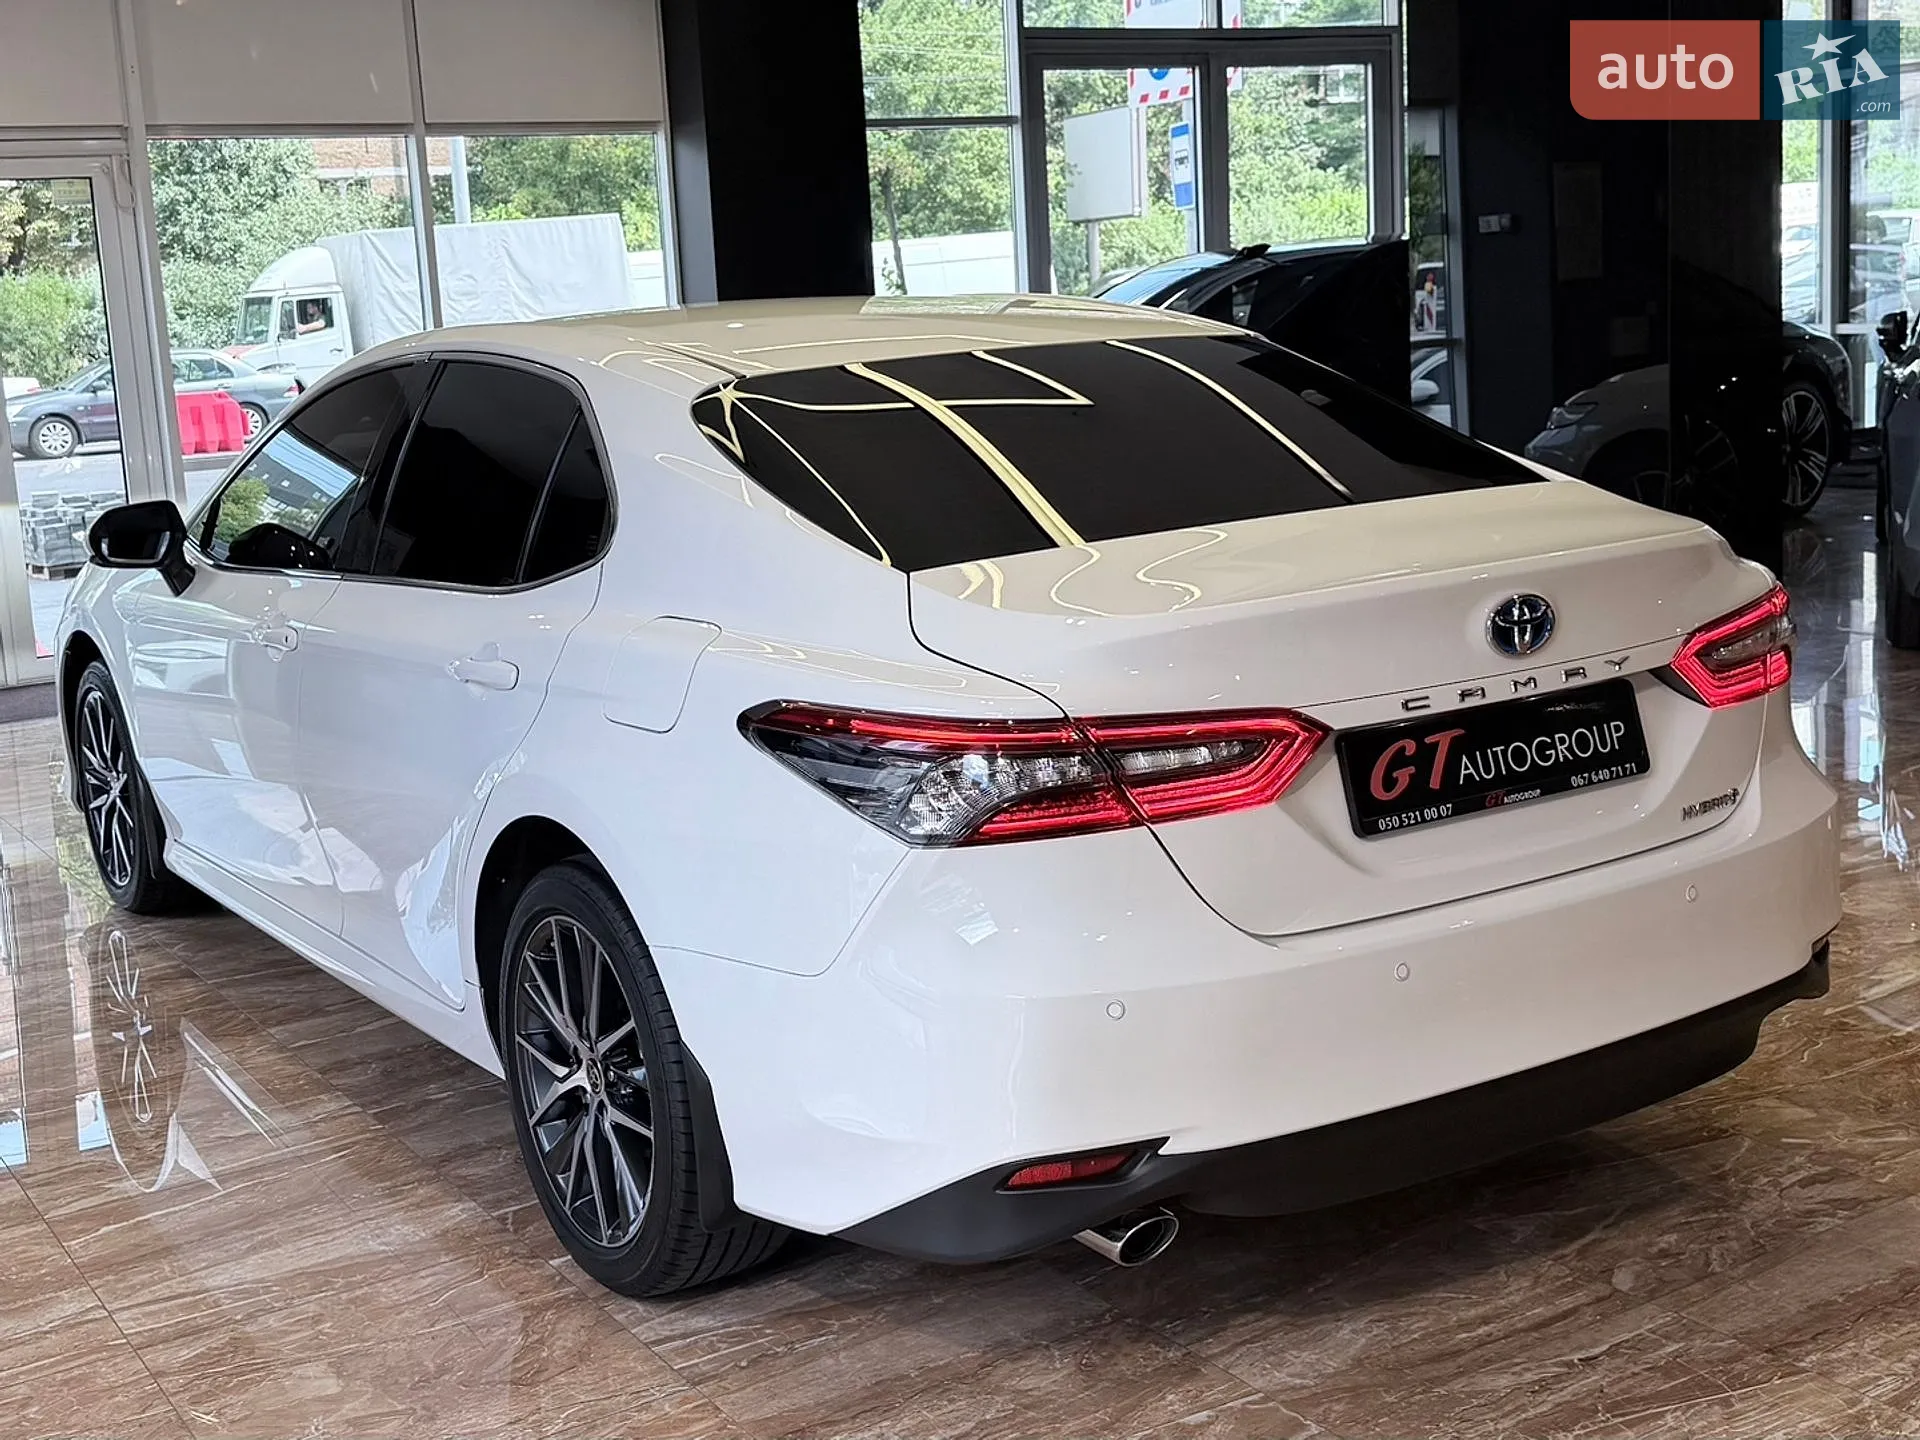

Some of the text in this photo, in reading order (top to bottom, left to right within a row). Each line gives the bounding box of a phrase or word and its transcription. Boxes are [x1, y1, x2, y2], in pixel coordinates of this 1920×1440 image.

[1401, 655, 1630, 712] CAMRY
[1370, 721, 1625, 801] GT AUTOGROUP
[1570, 762, 1637, 788] 067 640 71 71
[1503, 788, 1542, 804] AUTOGROUP
[1378, 803, 1453, 831] 050 521 00 07
